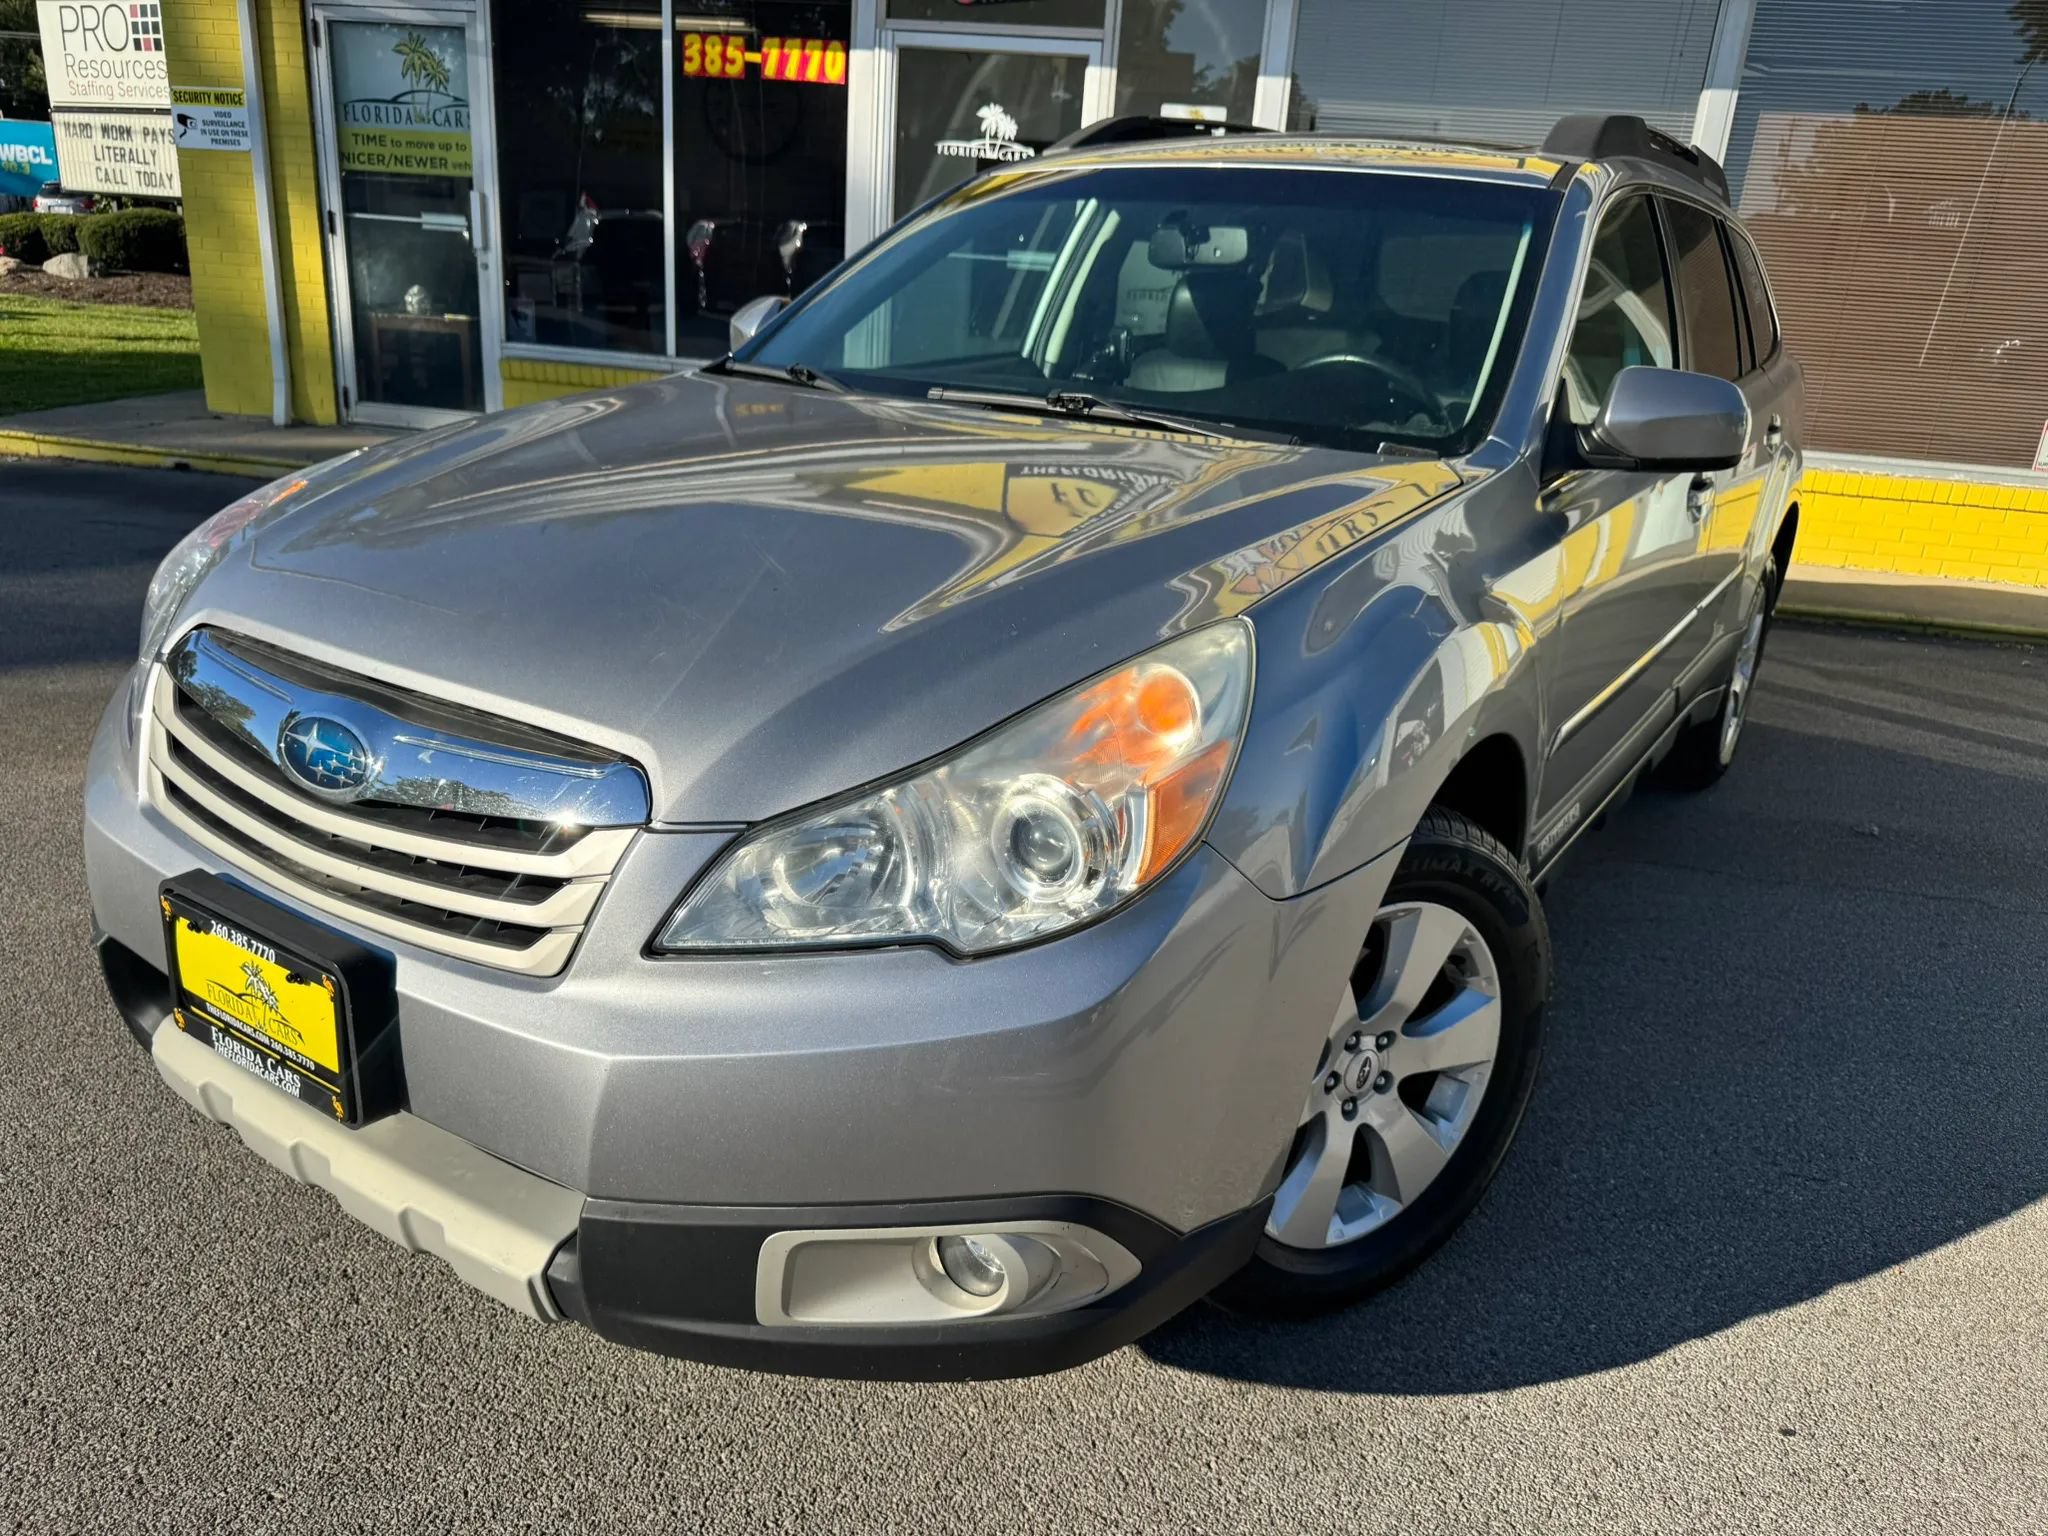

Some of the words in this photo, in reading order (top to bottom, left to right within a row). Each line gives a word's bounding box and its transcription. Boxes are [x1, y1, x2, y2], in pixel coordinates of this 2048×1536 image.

[59, 3, 129, 52] PRO
[64, 53, 168, 80] Resources
[683, 33, 845, 82] 385-7770
[68, 80, 114, 100] Staffing
[117, 82, 170, 99] Services
[173, 90, 212, 104] SECURITY
[213, 91, 244, 106] NOTICE
[201, 119, 245, 129] SURVEILLANCE
[213, 110, 232, 118] VIDEO
[343, 103, 413, 126] FLORIDA
[63, 121, 93, 139] HARD
[100, 123, 133, 142] WORK
[143, 126, 176, 145] PAYS
[208, 129, 220, 137] USE
[220, 129, 229, 137] ON
[230, 130, 248, 138] THESE
[210, 138, 241, 146] PREMISES
[351, 132, 387, 148] TIME
[390, 138, 402, 148] to
[405, 140, 435, 150] move
[438, 141, 453, 154] up
[455, 141, 467, 152] to
[0, 143, 53, 165] WBCL
[93, 144, 157, 166] LITERALLY
[340, 151, 449, 170] NICER/NEWER
[937, 143, 986, 159] FLORIDA
[95, 166, 128, 185] CALL
[136, 170, 173, 189] TODAY
[210, 919, 276, 964] 260.385.7770
[205, 981, 254, 1020] FLORIDA
[268, 1016, 299, 1047] CARS
[210, 1025, 264, 1068] FLORIDA
[266, 1057, 302, 1089] CARS
[213, 1041, 301, 1099] THEFLORIDACARS.COM
